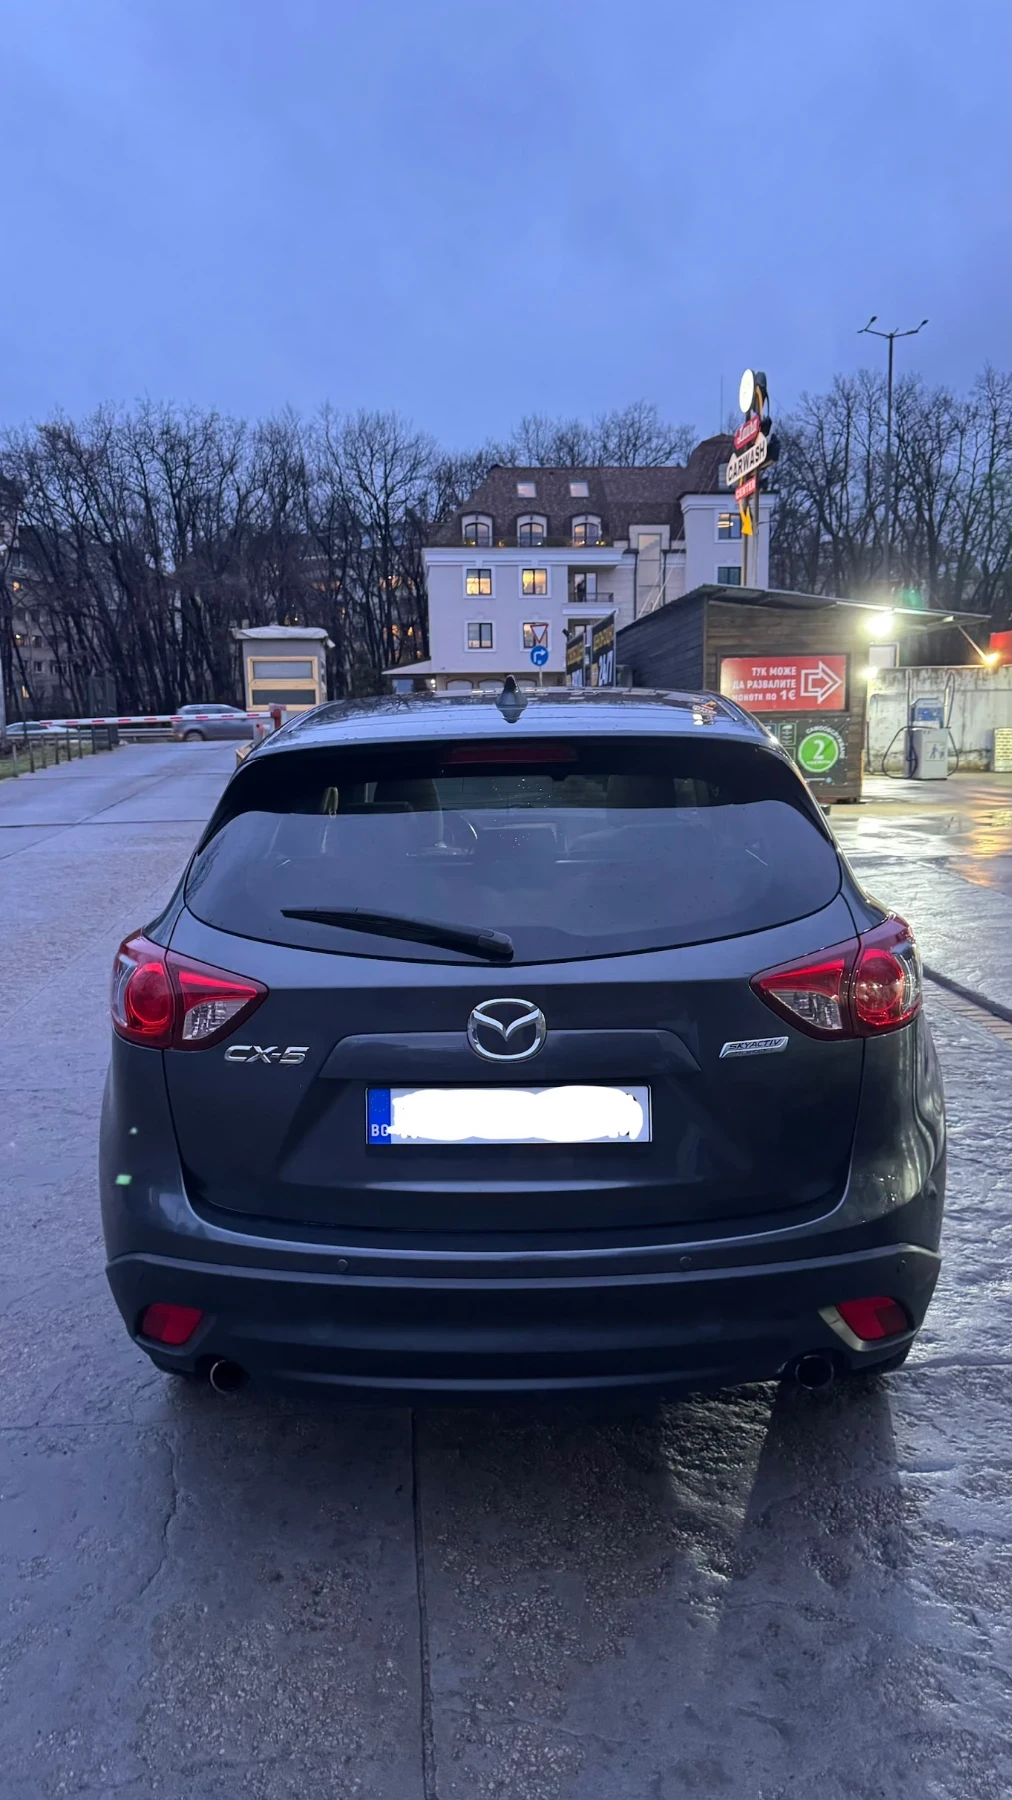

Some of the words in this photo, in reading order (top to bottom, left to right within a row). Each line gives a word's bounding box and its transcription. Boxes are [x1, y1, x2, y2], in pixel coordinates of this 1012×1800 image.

[728, 441, 765, 481] CARWASH
[752, 667, 767, 676] ТУК
[769, 667, 797, 676] МОЖЕ
[732, 680, 744, 690] ДА
[747, 680, 797, 689] РАЗВАЛИТЕ
[779, 690, 797, 701] 1€
[813, 739, 825, 760] 2
[729, 1039, 782, 1050] SKYACTIV
[224, 1045, 310, 1065] CX-5
